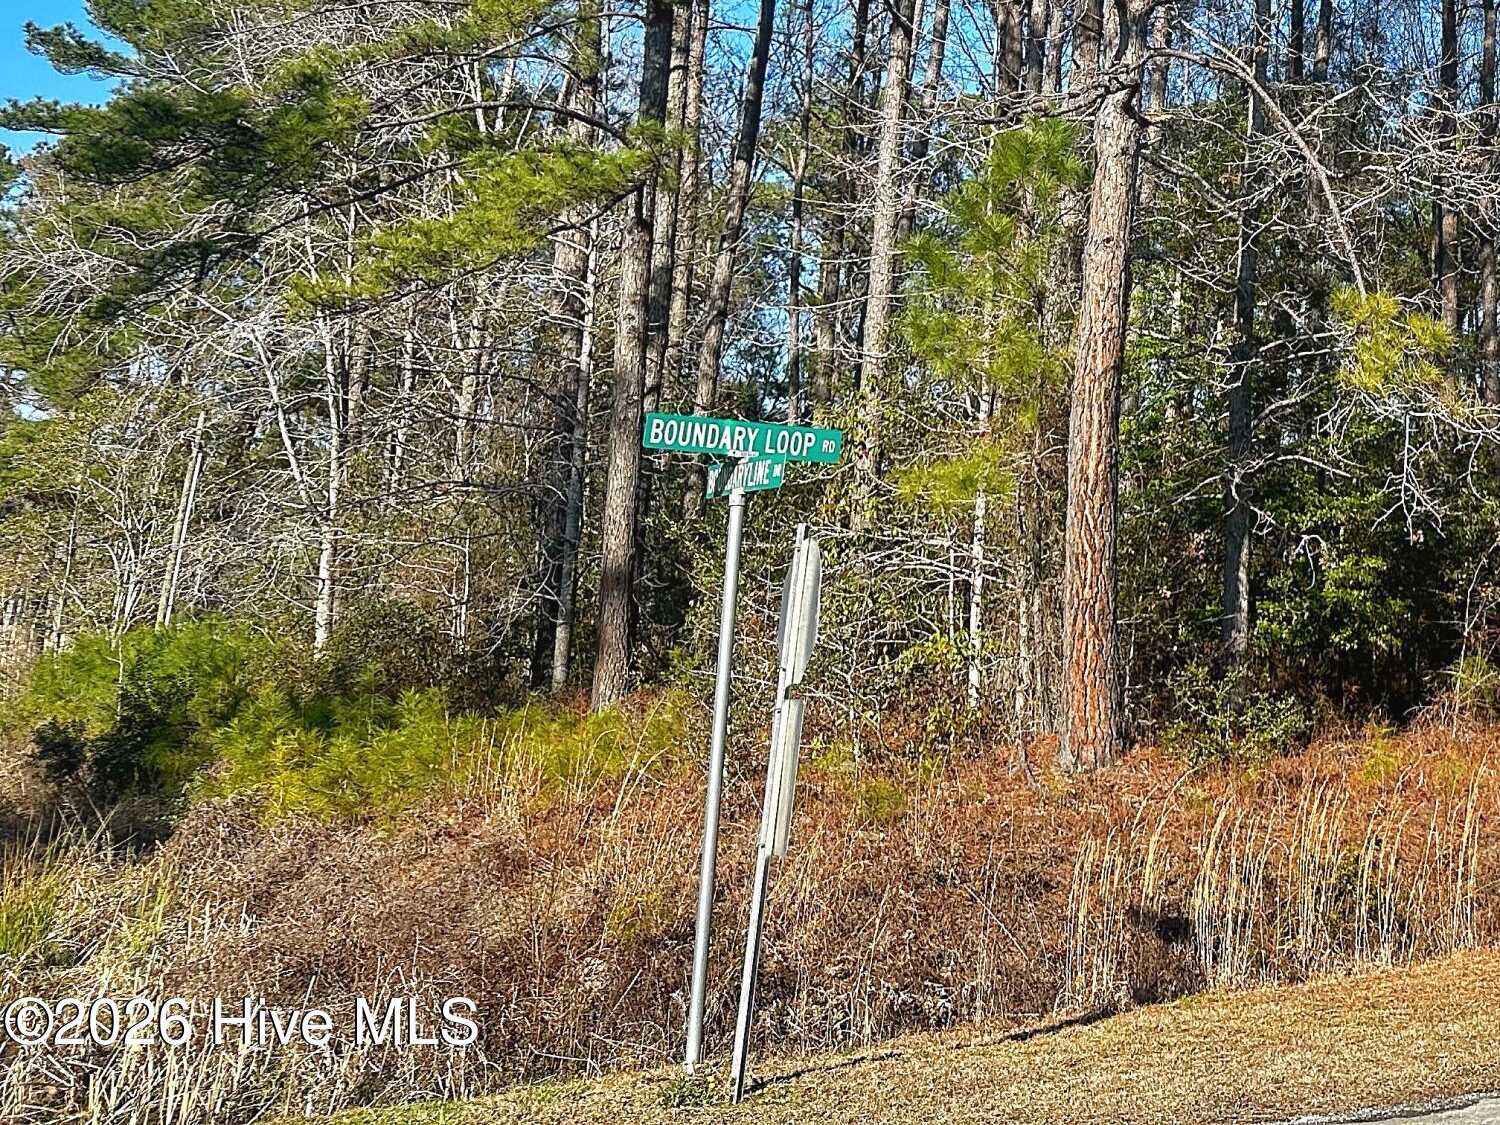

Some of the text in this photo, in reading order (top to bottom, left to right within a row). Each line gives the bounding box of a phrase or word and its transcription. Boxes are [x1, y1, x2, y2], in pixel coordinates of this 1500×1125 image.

[649, 418, 836, 456] BOUNDARY LOOP RD
